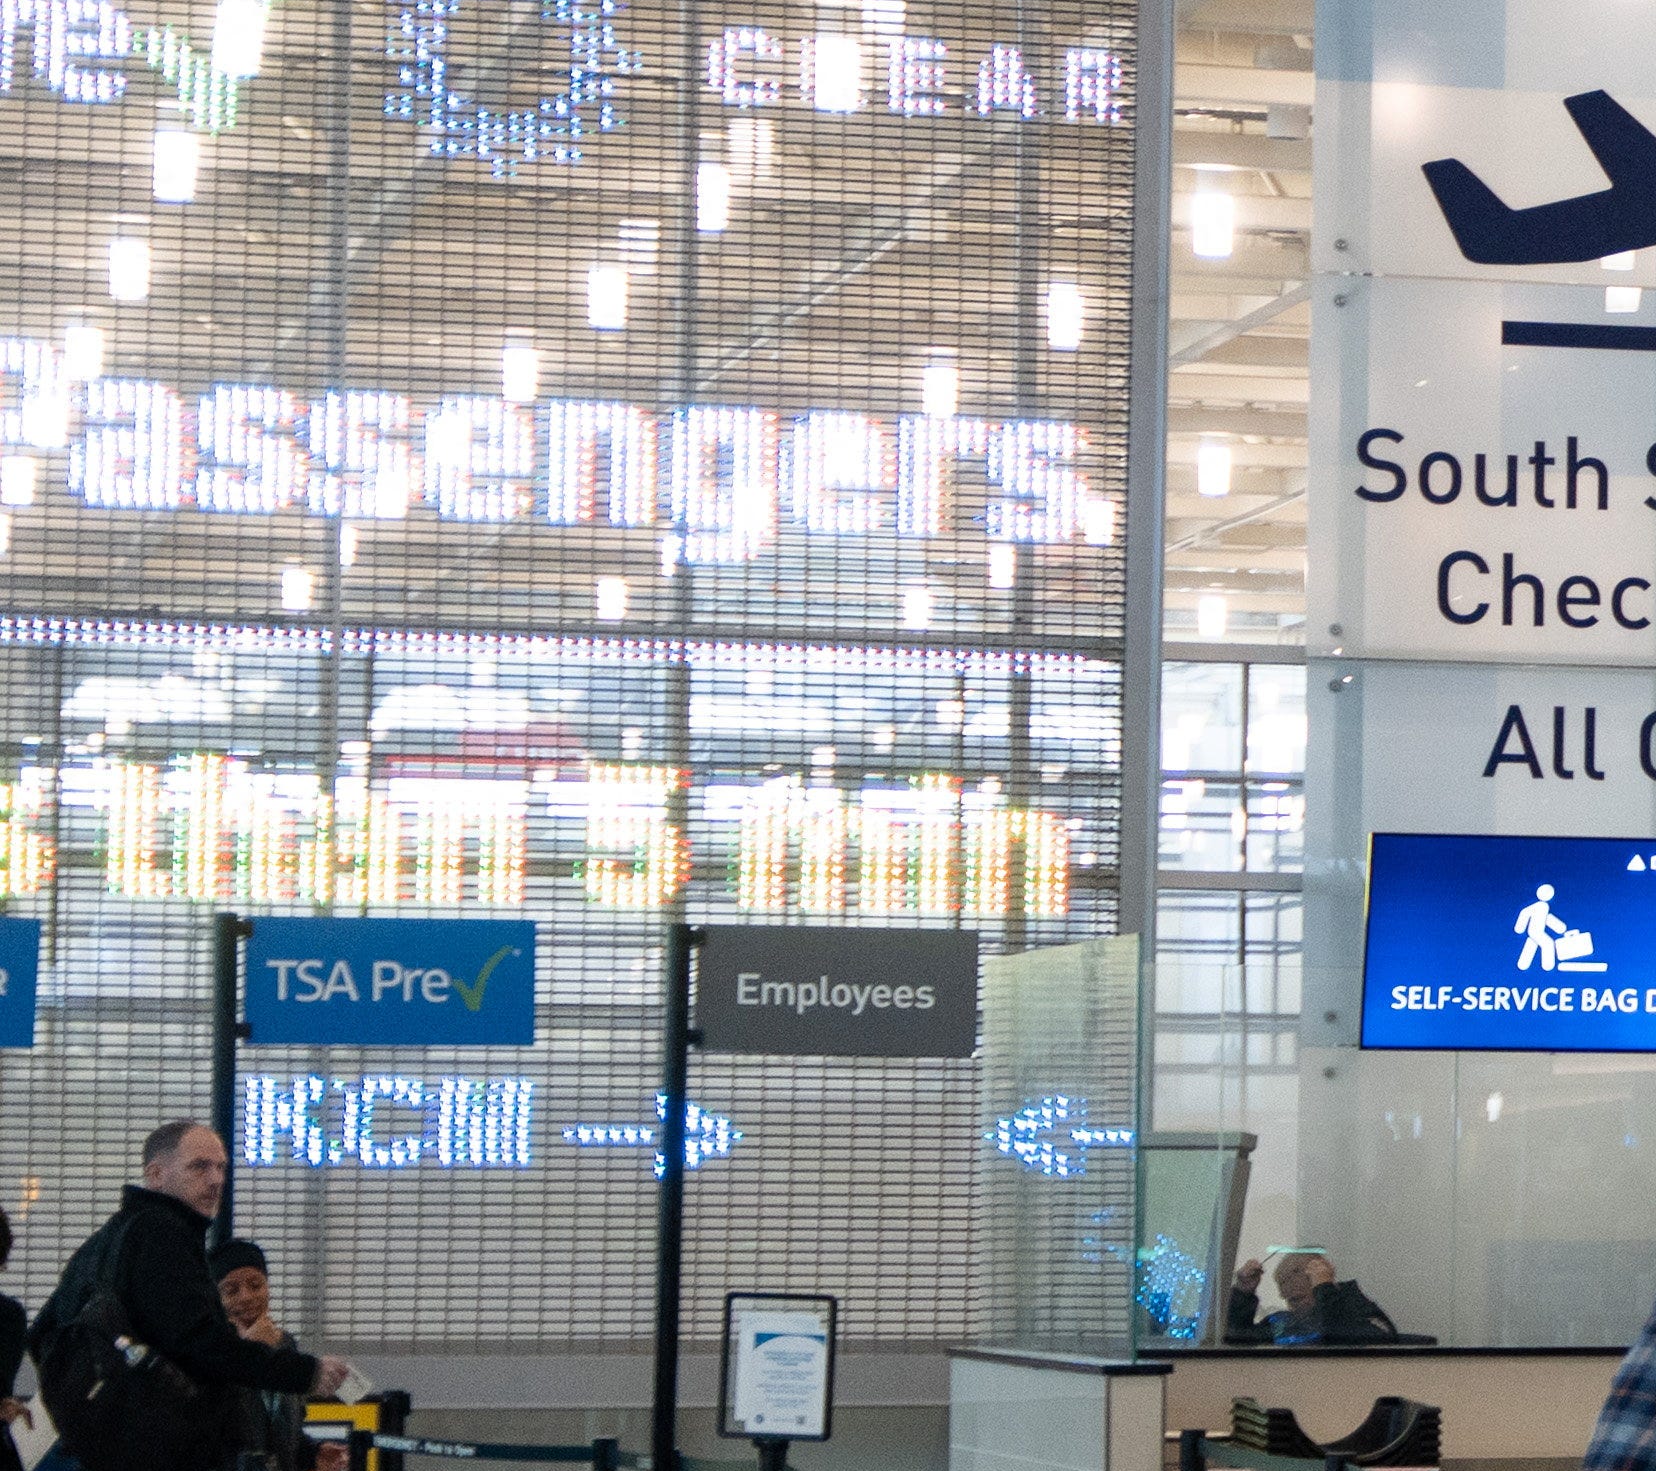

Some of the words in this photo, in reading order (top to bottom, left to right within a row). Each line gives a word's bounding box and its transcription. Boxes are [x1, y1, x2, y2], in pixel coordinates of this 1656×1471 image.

[1354, 428, 1610, 510] South
[1483, 704, 1604, 780] All
[267, 960, 360, 1002] TSA
[372, 960, 451, 1003] Pre
[737, 974, 934, 1015] Employees
[1391, 985, 1574, 1012] SELF-SERVICE
[1581, 988, 1638, 1013] BAG
